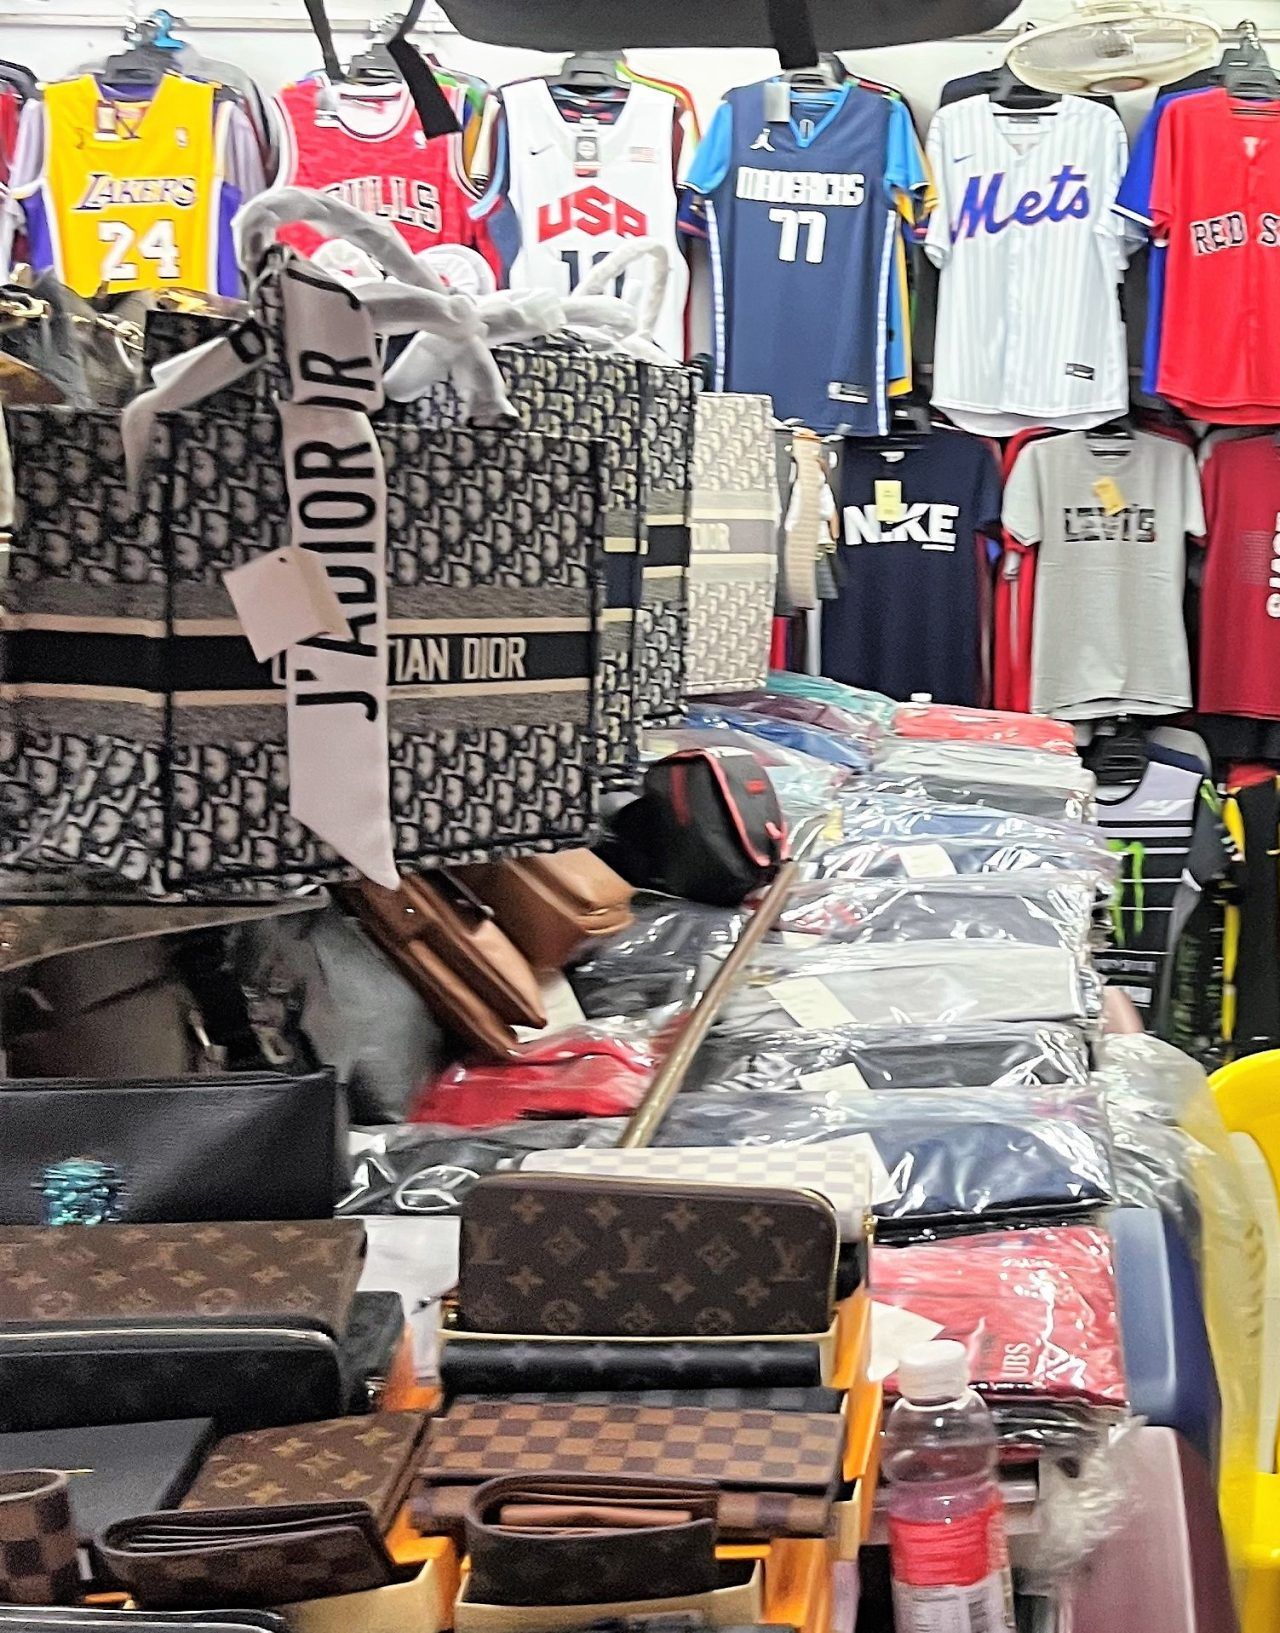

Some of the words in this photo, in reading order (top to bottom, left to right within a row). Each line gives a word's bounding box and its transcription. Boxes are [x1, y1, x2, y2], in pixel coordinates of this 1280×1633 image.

[70, 173, 197, 212] LAKERS
[322, 175, 443, 234] ULLS
[537, 184, 648, 243] USA
[950, 164, 1090, 244] Mets
[97, 218, 182, 282] 24
[768, 206, 828, 264] 77
[1189, 211, 1249, 257] RED
[463, 636, 528, 682] DIOR
